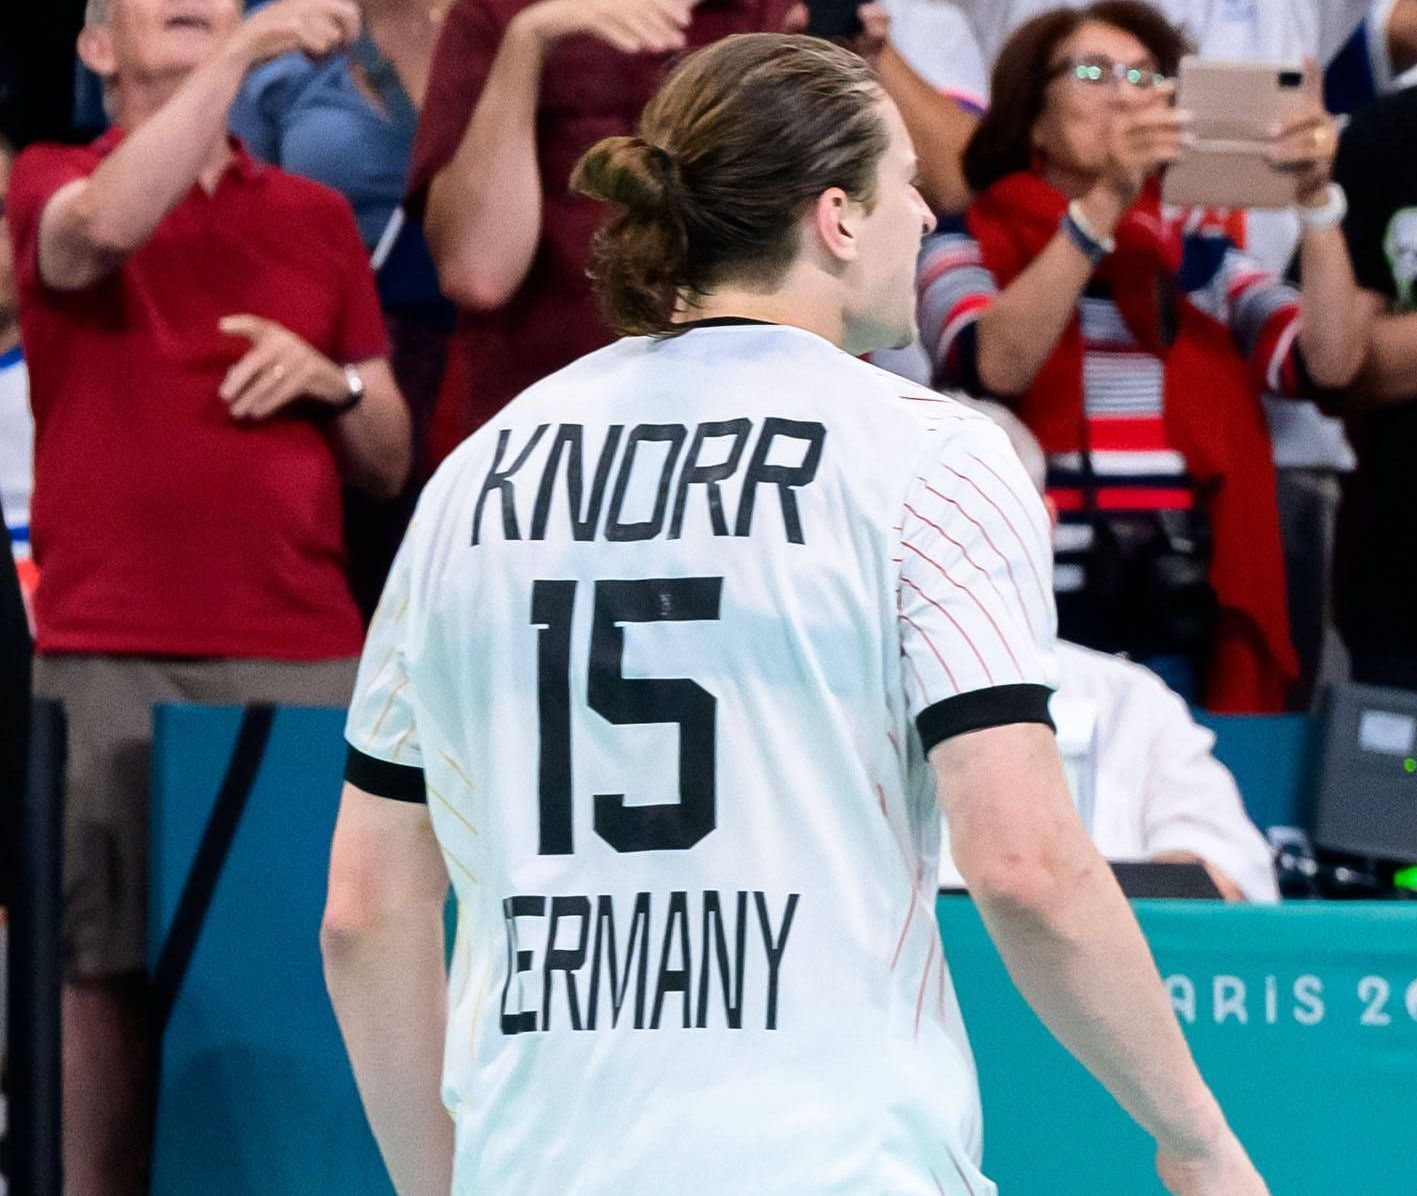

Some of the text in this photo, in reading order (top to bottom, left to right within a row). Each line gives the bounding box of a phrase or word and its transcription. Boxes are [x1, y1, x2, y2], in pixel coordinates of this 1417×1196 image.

[470, 416, 827, 547] KNORR
[530, 576, 725, 855] 15
[1165, 974, 1326, 1026] ARIS
